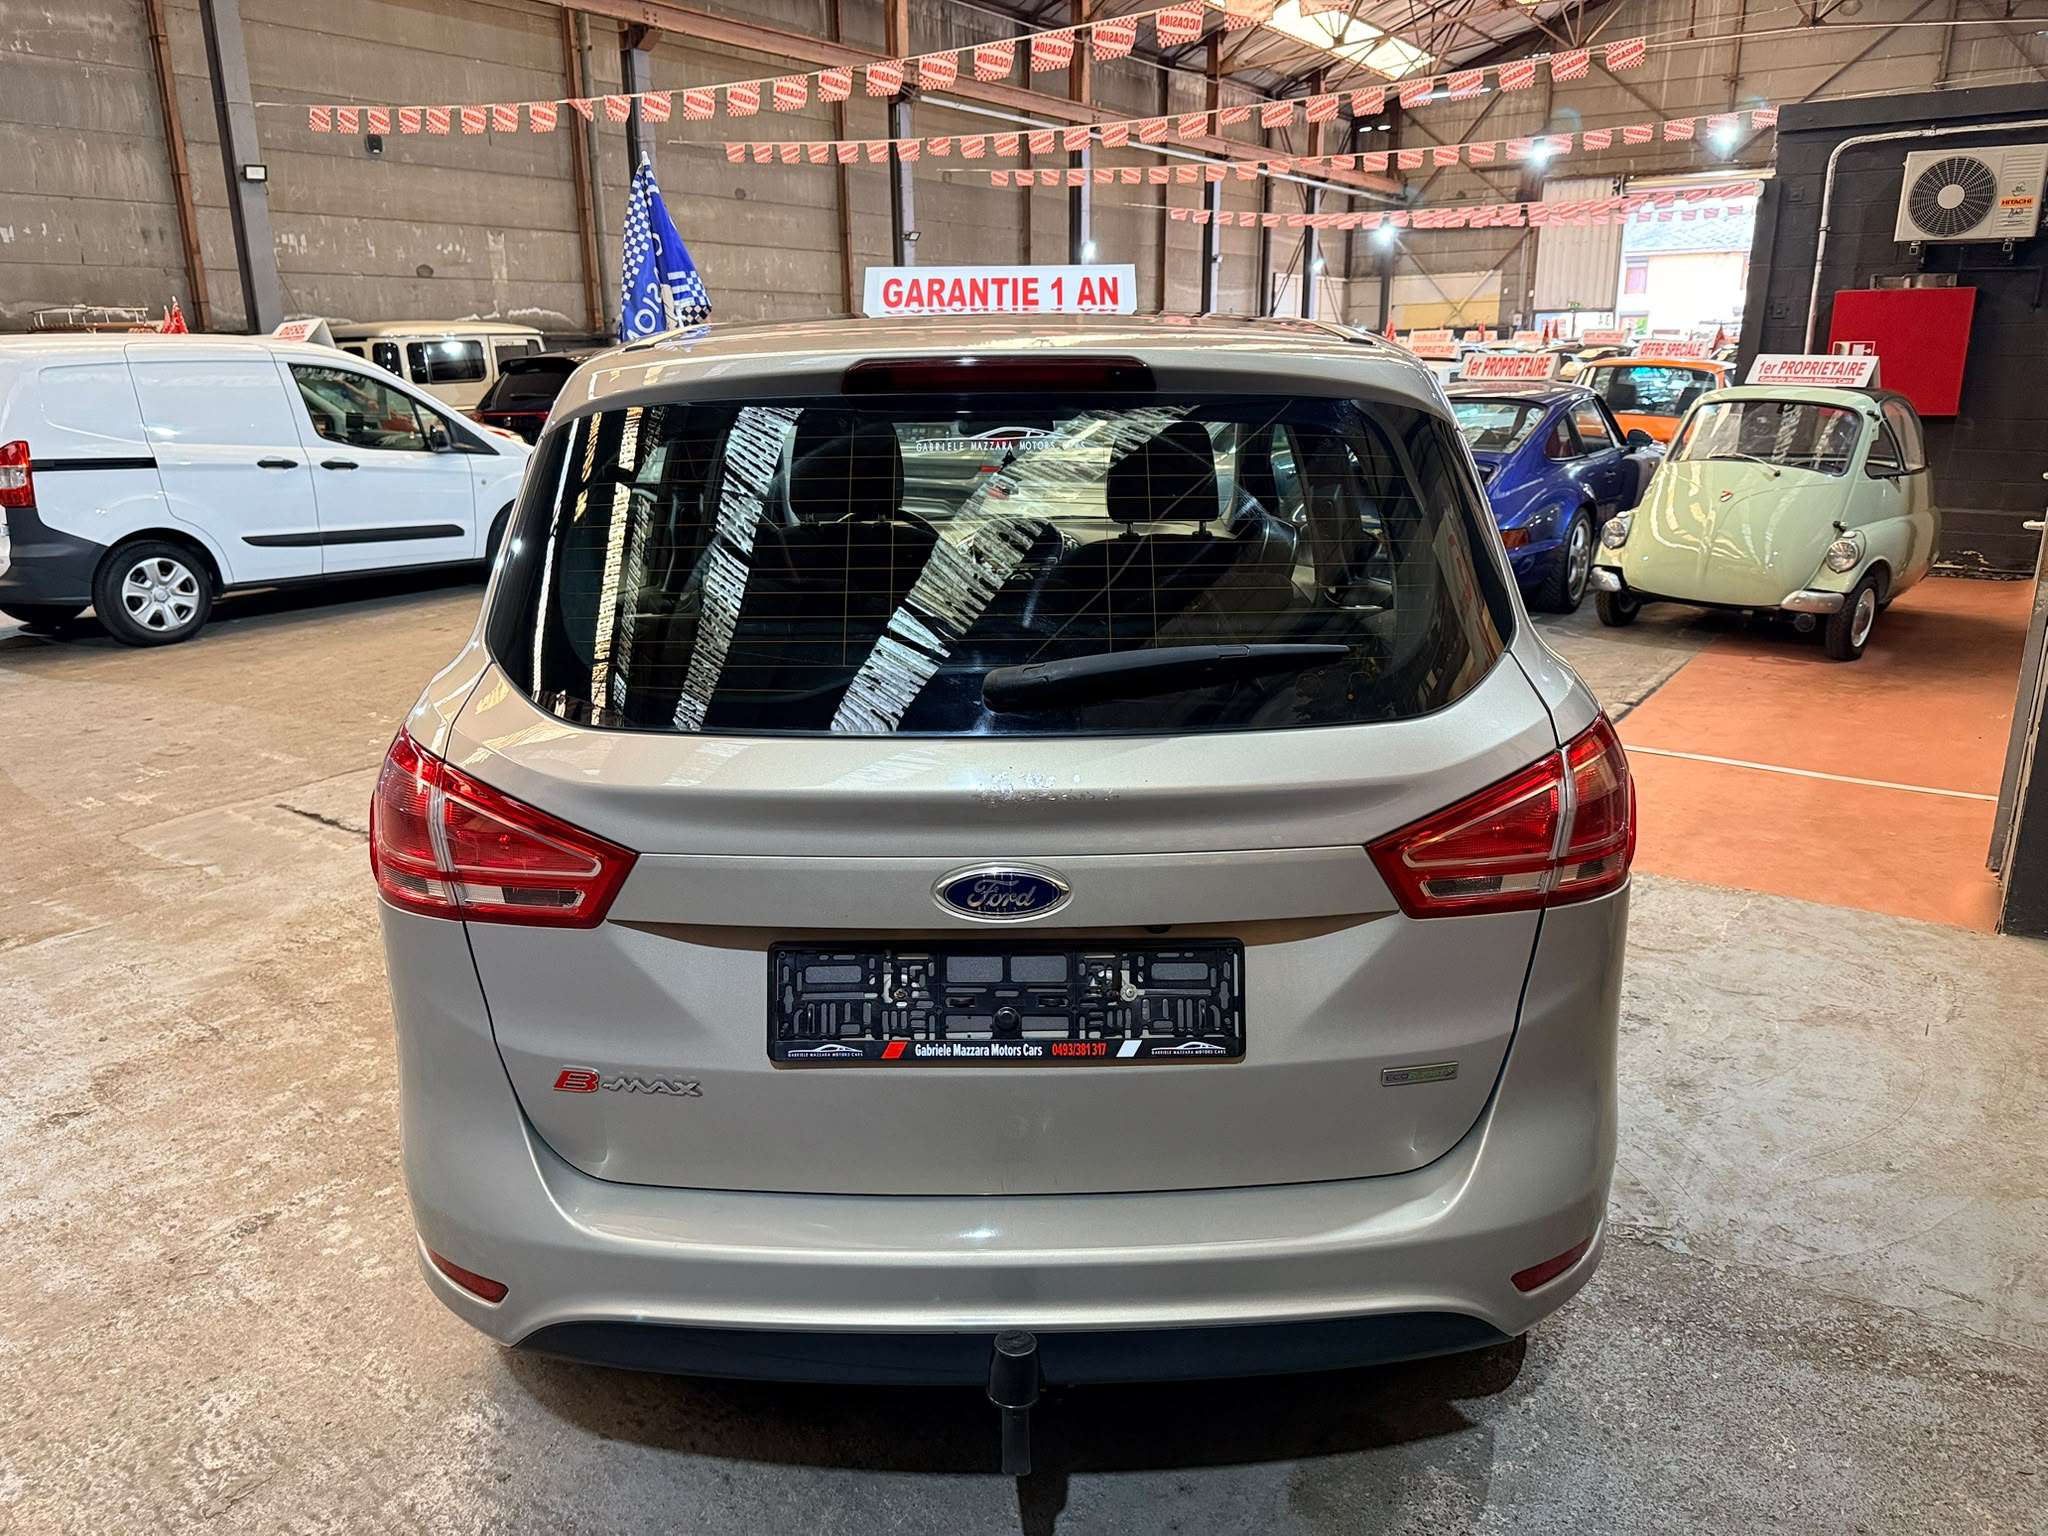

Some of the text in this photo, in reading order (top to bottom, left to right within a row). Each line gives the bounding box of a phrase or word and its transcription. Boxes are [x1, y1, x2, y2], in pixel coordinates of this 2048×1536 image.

[882, 276, 1118, 308] GARANTIE 1 AN
[1640, 342, 1704, 357] OFFRE SPECIALE
[1465, 356, 1552, 377] 1er PROPRIETAIRE
[1760, 360, 1867, 377] 1er PROPRIETAIRE
[916, 441, 964, 452] GABRIELE
[971, 441, 1013, 451] MAZZARA
[1019, 441, 1055, 451] MOTORS
[967, 879, 1037, 908] Ford
[915, 1043, 951, 1057] Gabriele
[953, 1043, 989, 1057] Mazzara
[990, 1043, 1023, 1057] Motors
[1024, 1043, 1043, 1057] Cars
[552, 1064, 704, 1098] B-MAX
